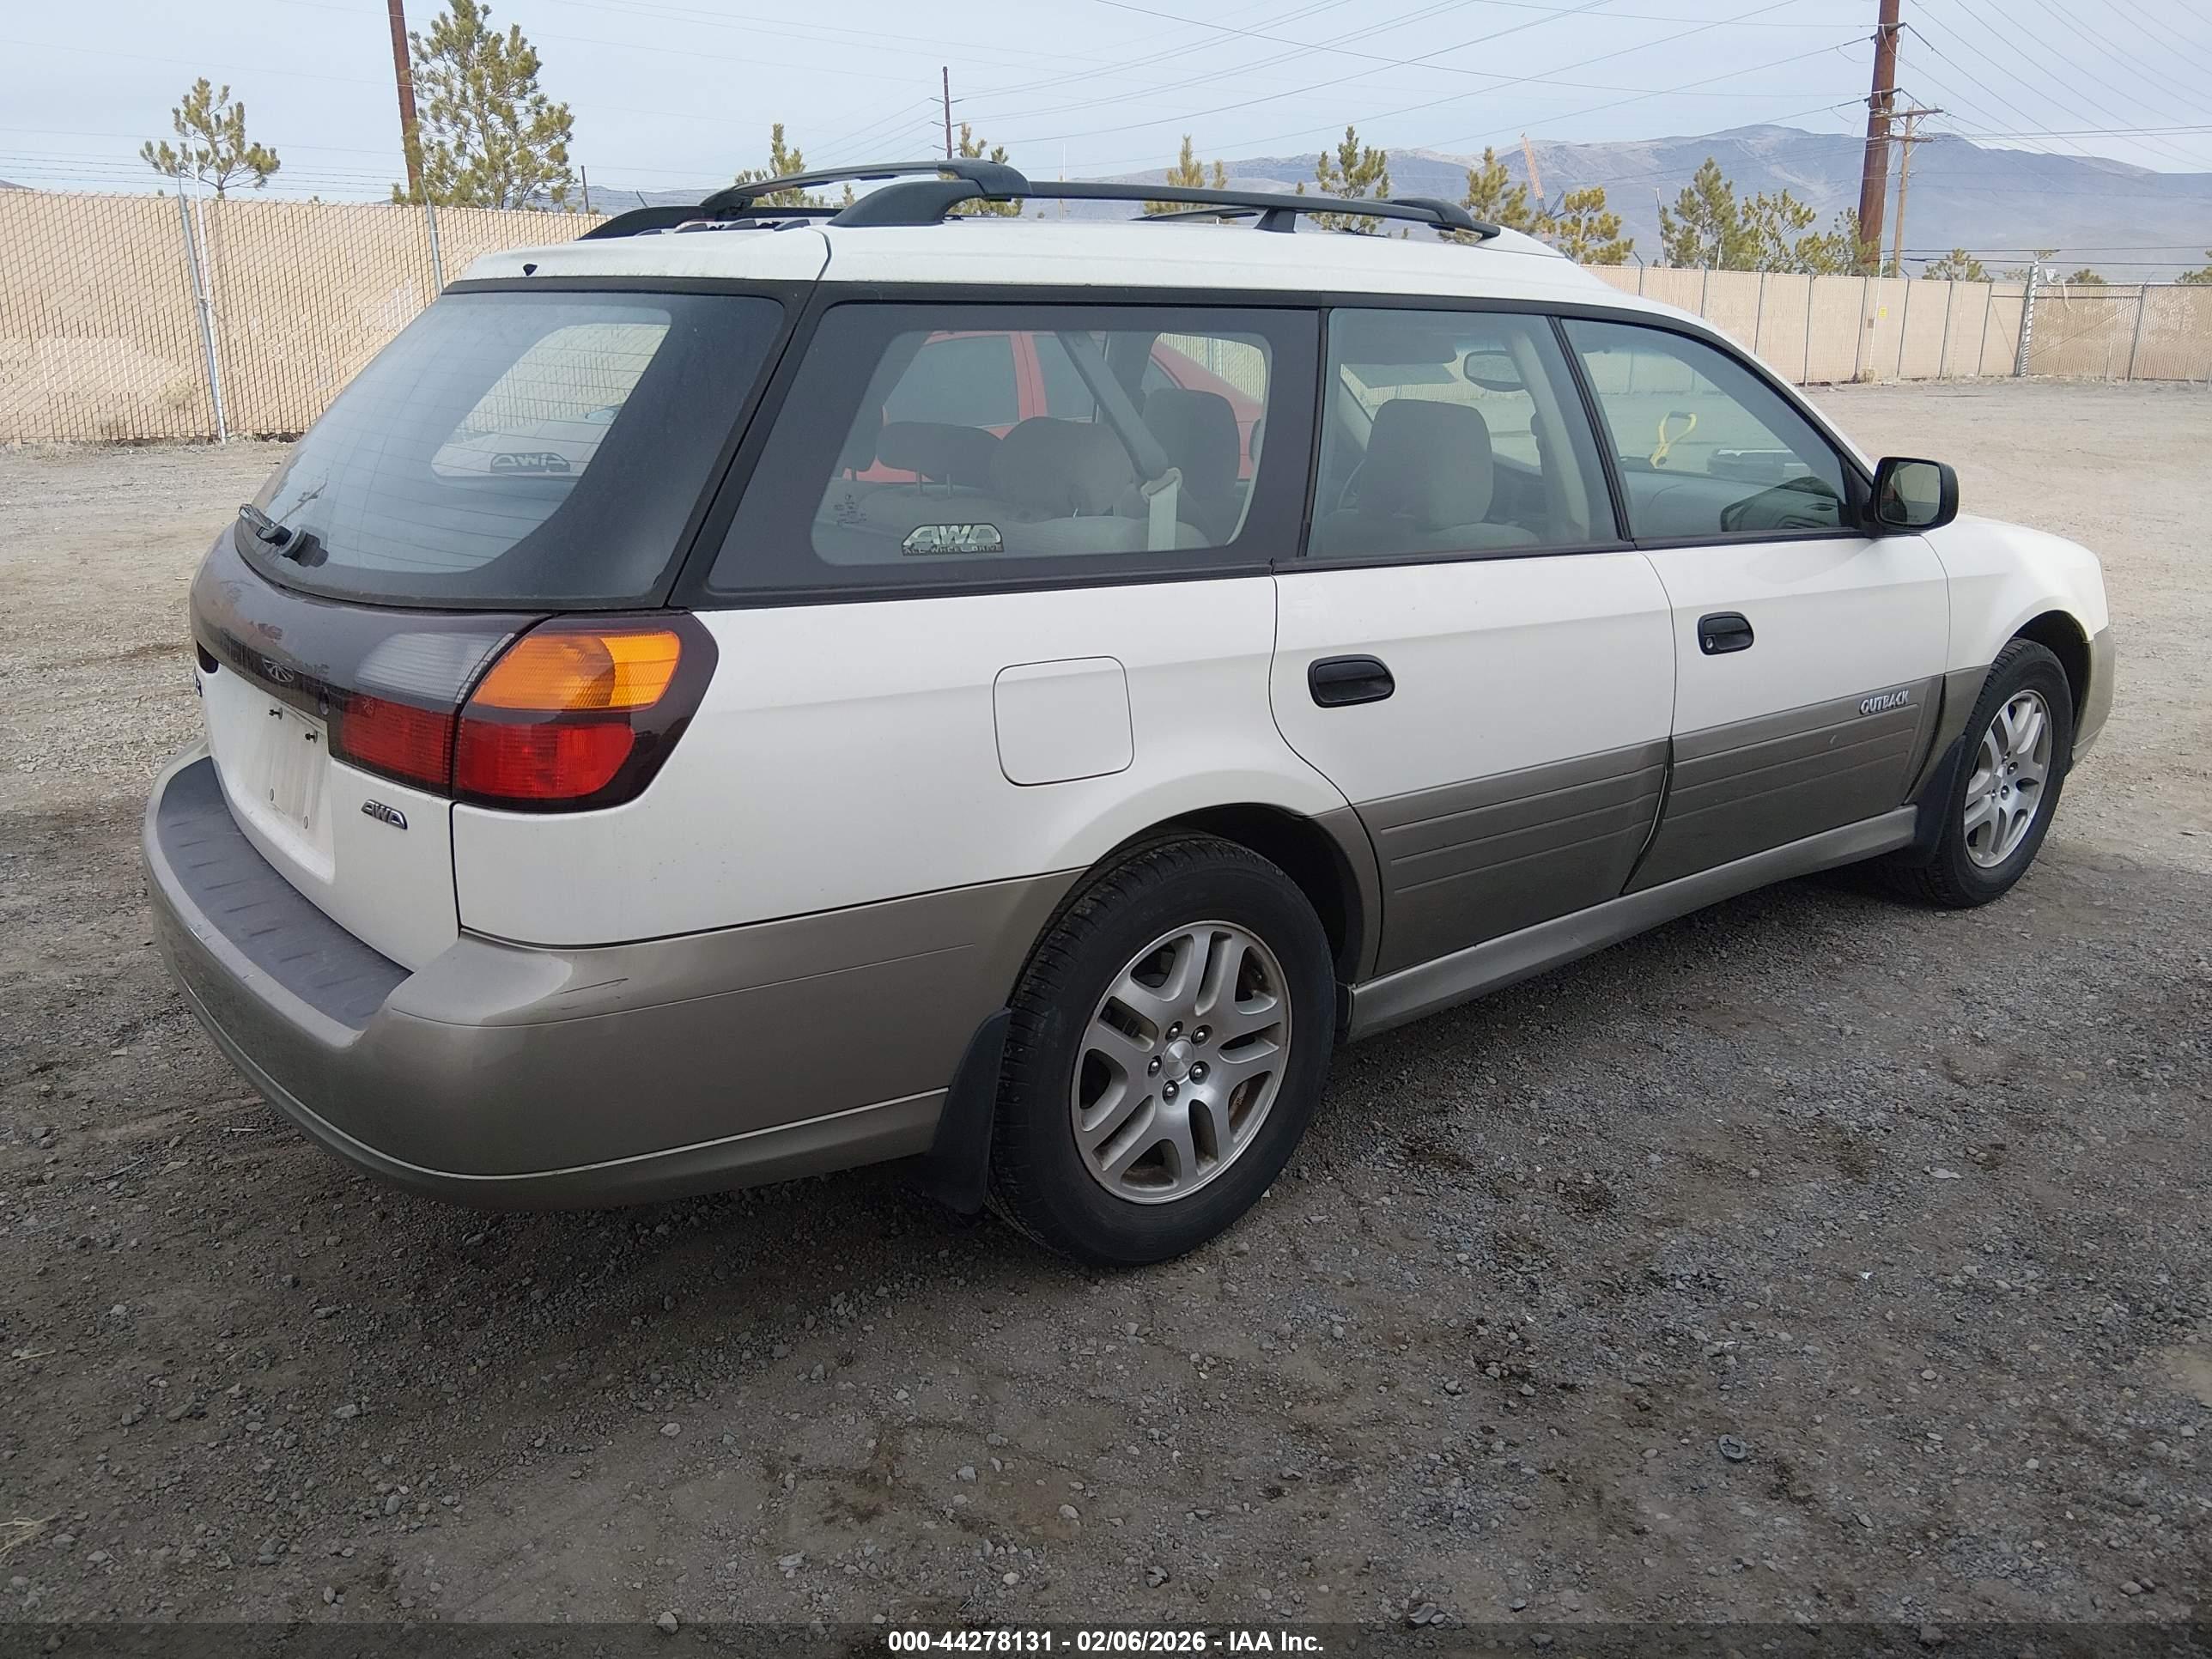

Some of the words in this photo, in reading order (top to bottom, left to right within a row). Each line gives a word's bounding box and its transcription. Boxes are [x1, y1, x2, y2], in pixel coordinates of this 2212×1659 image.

[902, 524, 1001, 545] AWD
[1859, 690, 1909, 714] OUTBACK
[361, 799, 407, 830] AWD
